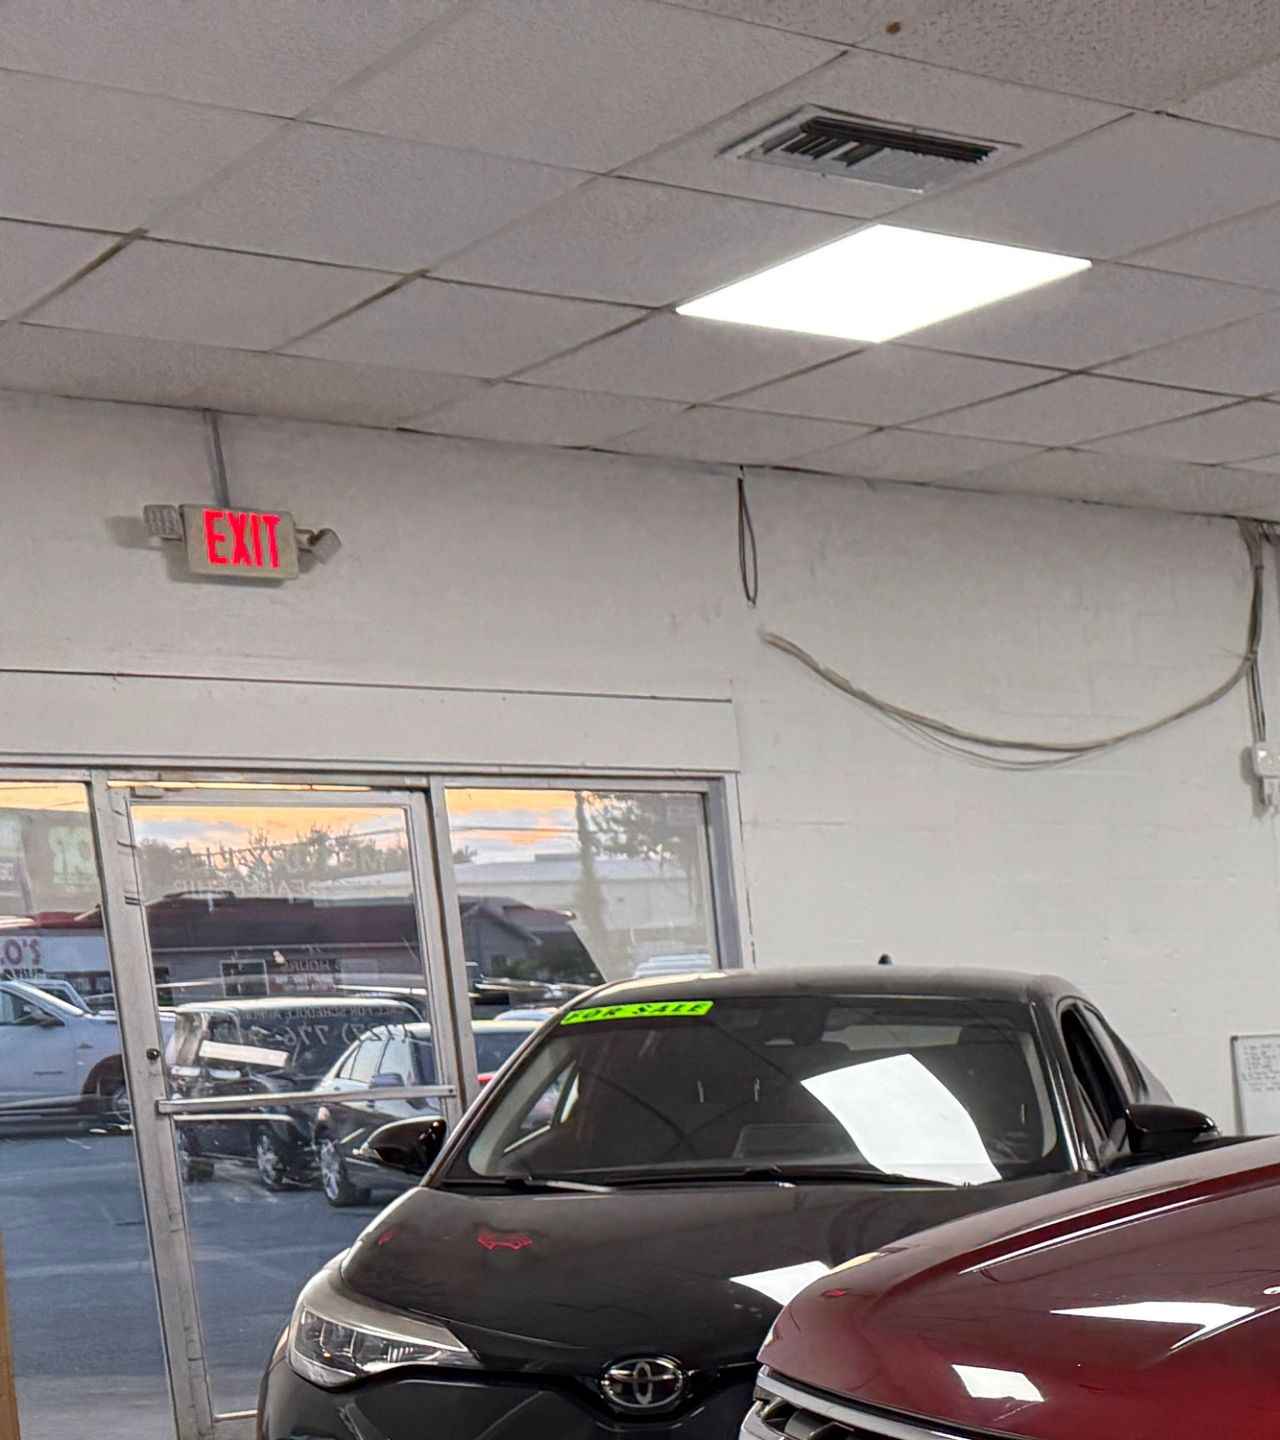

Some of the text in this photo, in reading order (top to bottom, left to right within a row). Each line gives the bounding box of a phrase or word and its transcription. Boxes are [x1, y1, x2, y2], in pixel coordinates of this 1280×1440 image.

[203, 508, 281, 568] EXIT
[566, 1002, 708, 1022] FOR SALE
